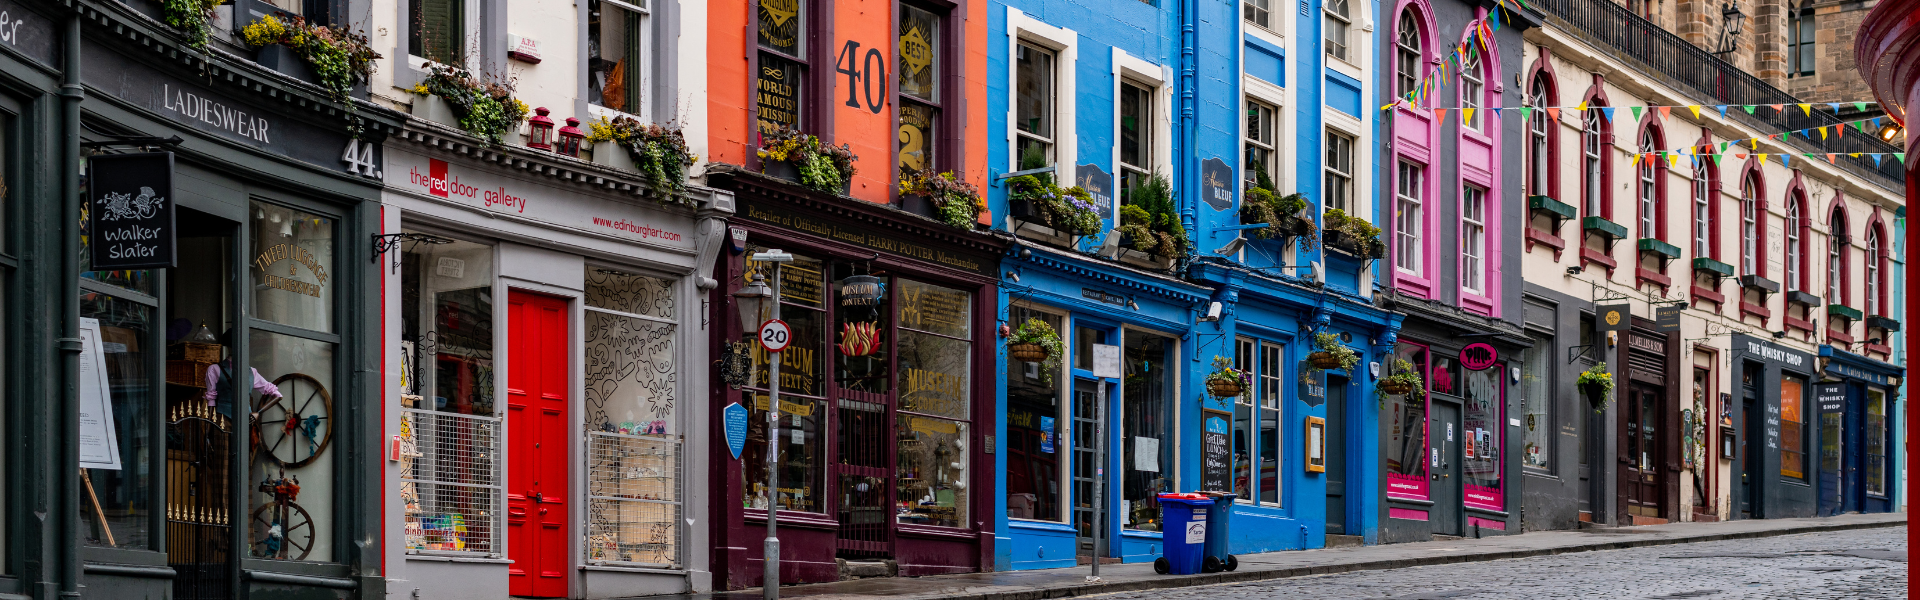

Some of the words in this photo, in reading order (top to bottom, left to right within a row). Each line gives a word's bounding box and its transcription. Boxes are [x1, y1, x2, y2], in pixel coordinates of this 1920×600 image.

[905, 40, 926, 60] BEST
[836, 40, 885, 114] 40
[757, 78, 792, 97] WORLD
[757, 91, 796, 112] AMOUS!
[164, 83, 270, 144] LADIESWEAR
[757, 105, 797, 125] DMISSION
[899, 107, 931, 129] UPERIOR
[899, 124, 924, 170] 2
[410, 165, 428, 188] the
[430, 173, 448, 192] red
[450, 175, 478, 199] door
[484, 187, 526, 213] gallery
[1214, 186, 1232, 203] BLEUE
[1090, 191, 1111, 209] BLEUE
[104, 225, 162, 242] walker
[592, 216, 682, 242] www.edinburghart.com
[748, 206, 780, 224] Retailer
[782, 215, 791, 227] of
[794, 216, 831, 239] Officially
[833, 226, 865, 244] Licensed
[868, 235, 898, 253] HARRY
[900, 241, 933, 260] POTTER
[937, 251, 979, 271] Merchandise
[108, 242, 159, 259] slater
[255, 243, 288, 272] TWEED
[290, 244, 329, 287] LUGGAGE
[290, 263, 297, 276] &
[264, 274, 320, 298] CHILDRENSWEAR
[842, 284, 873, 297] MUSEUM
[842, 297, 872, 307] CONTEXT
[763, 328, 787, 344] 20
[750, 339, 813, 377] MUEUM
[1748, 341, 1760, 356] THE
[1761, 343, 1785, 362] WHISKY
[1786, 352, 1803, 367] SHOP
[762, 370, 801, 389] CTEXT
[908, 368, 961, 401] MUSEUM
[918, 396, 951, 413] CONTEXT
